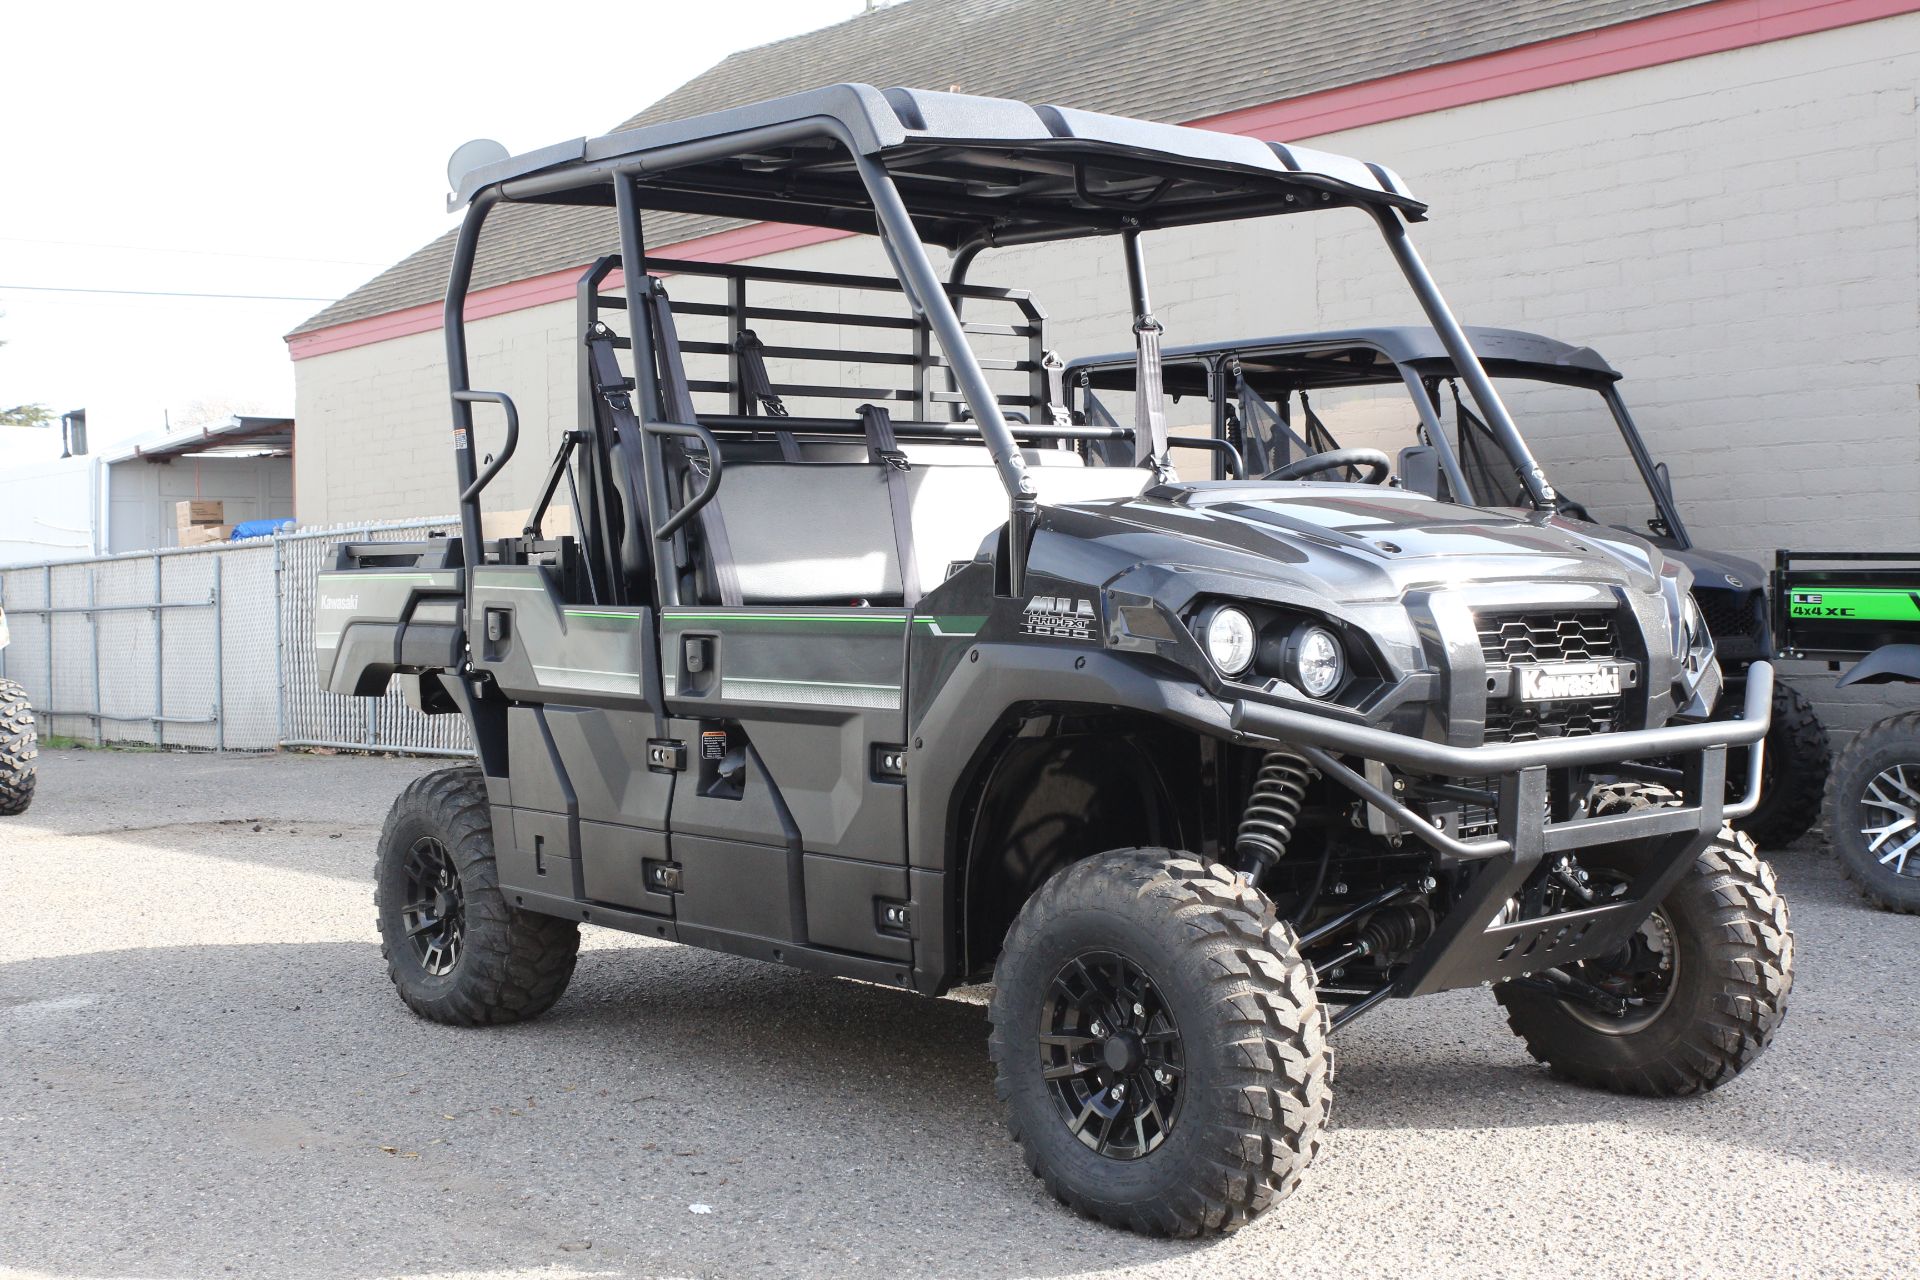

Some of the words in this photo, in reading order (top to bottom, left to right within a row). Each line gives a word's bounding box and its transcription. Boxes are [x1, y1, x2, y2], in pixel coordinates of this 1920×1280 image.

[321, 594, 359, 609] Kawasaki
[1793, 606, 1822, 616] 4x4
[1825, 607, 1855, 616] XC
[1522, 667, 1620, 699] Kawasaki
